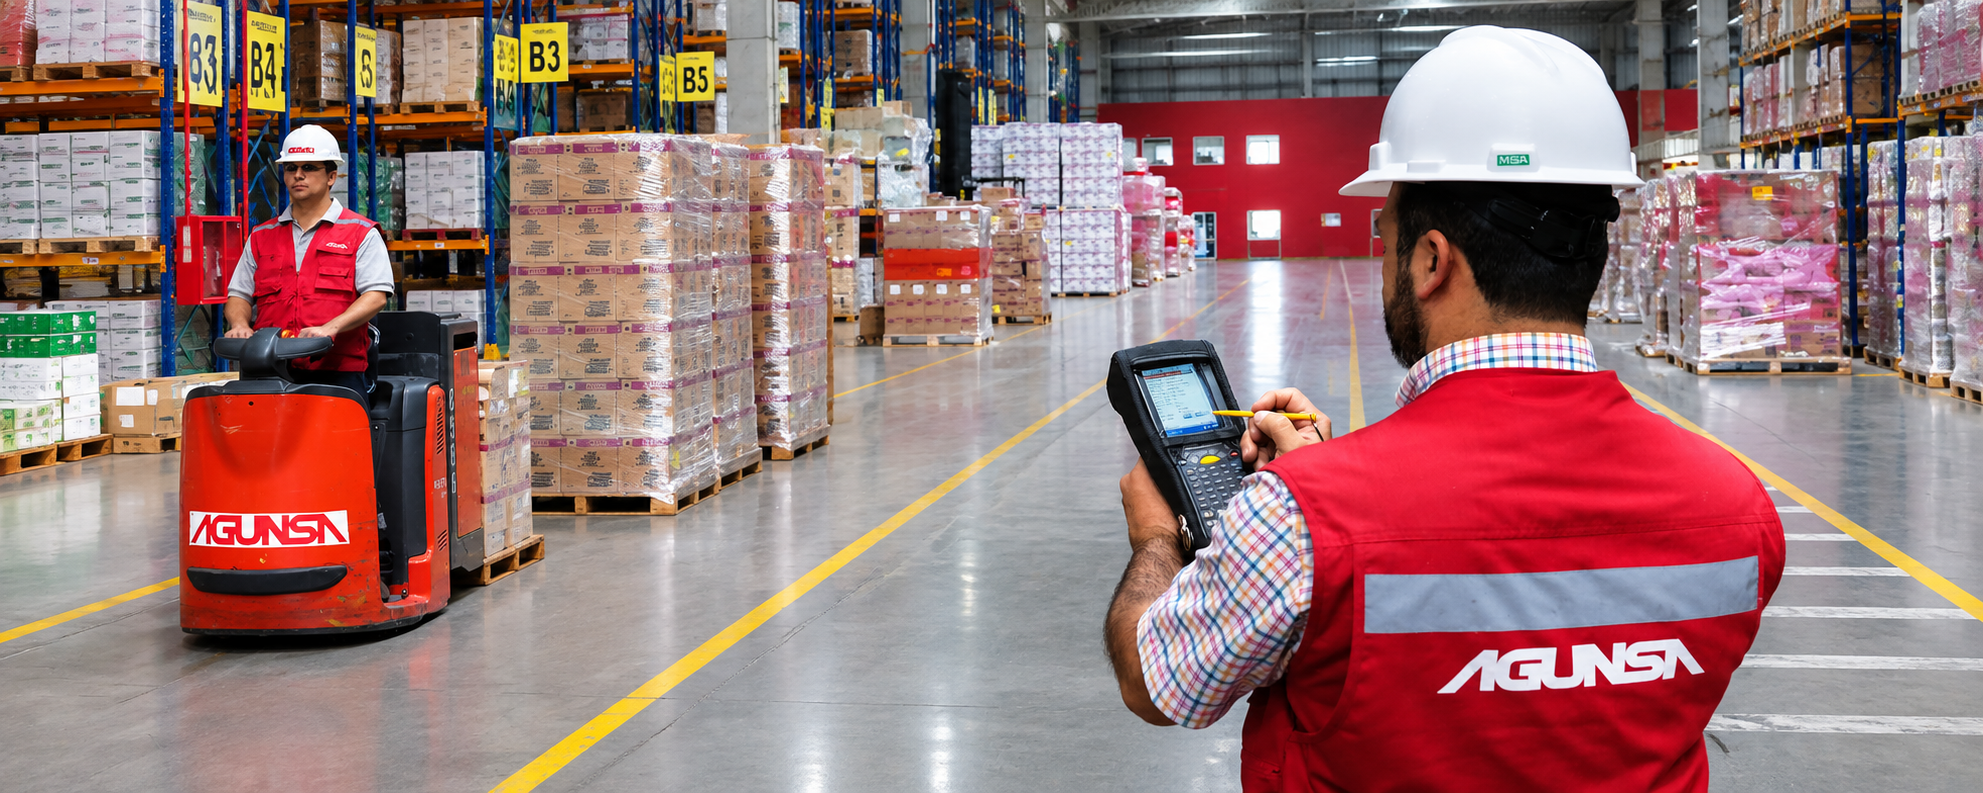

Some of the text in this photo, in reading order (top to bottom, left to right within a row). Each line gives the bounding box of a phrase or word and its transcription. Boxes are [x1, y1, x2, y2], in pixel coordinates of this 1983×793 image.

[530, 40, 560, 72] B3
[683, 65, 708, 93] B5
[1499, 155, 1529, 165] MSA
[191, 513, 348, 546] AGUNSA
[1437, 638, 1705, 694] AGUNSA
